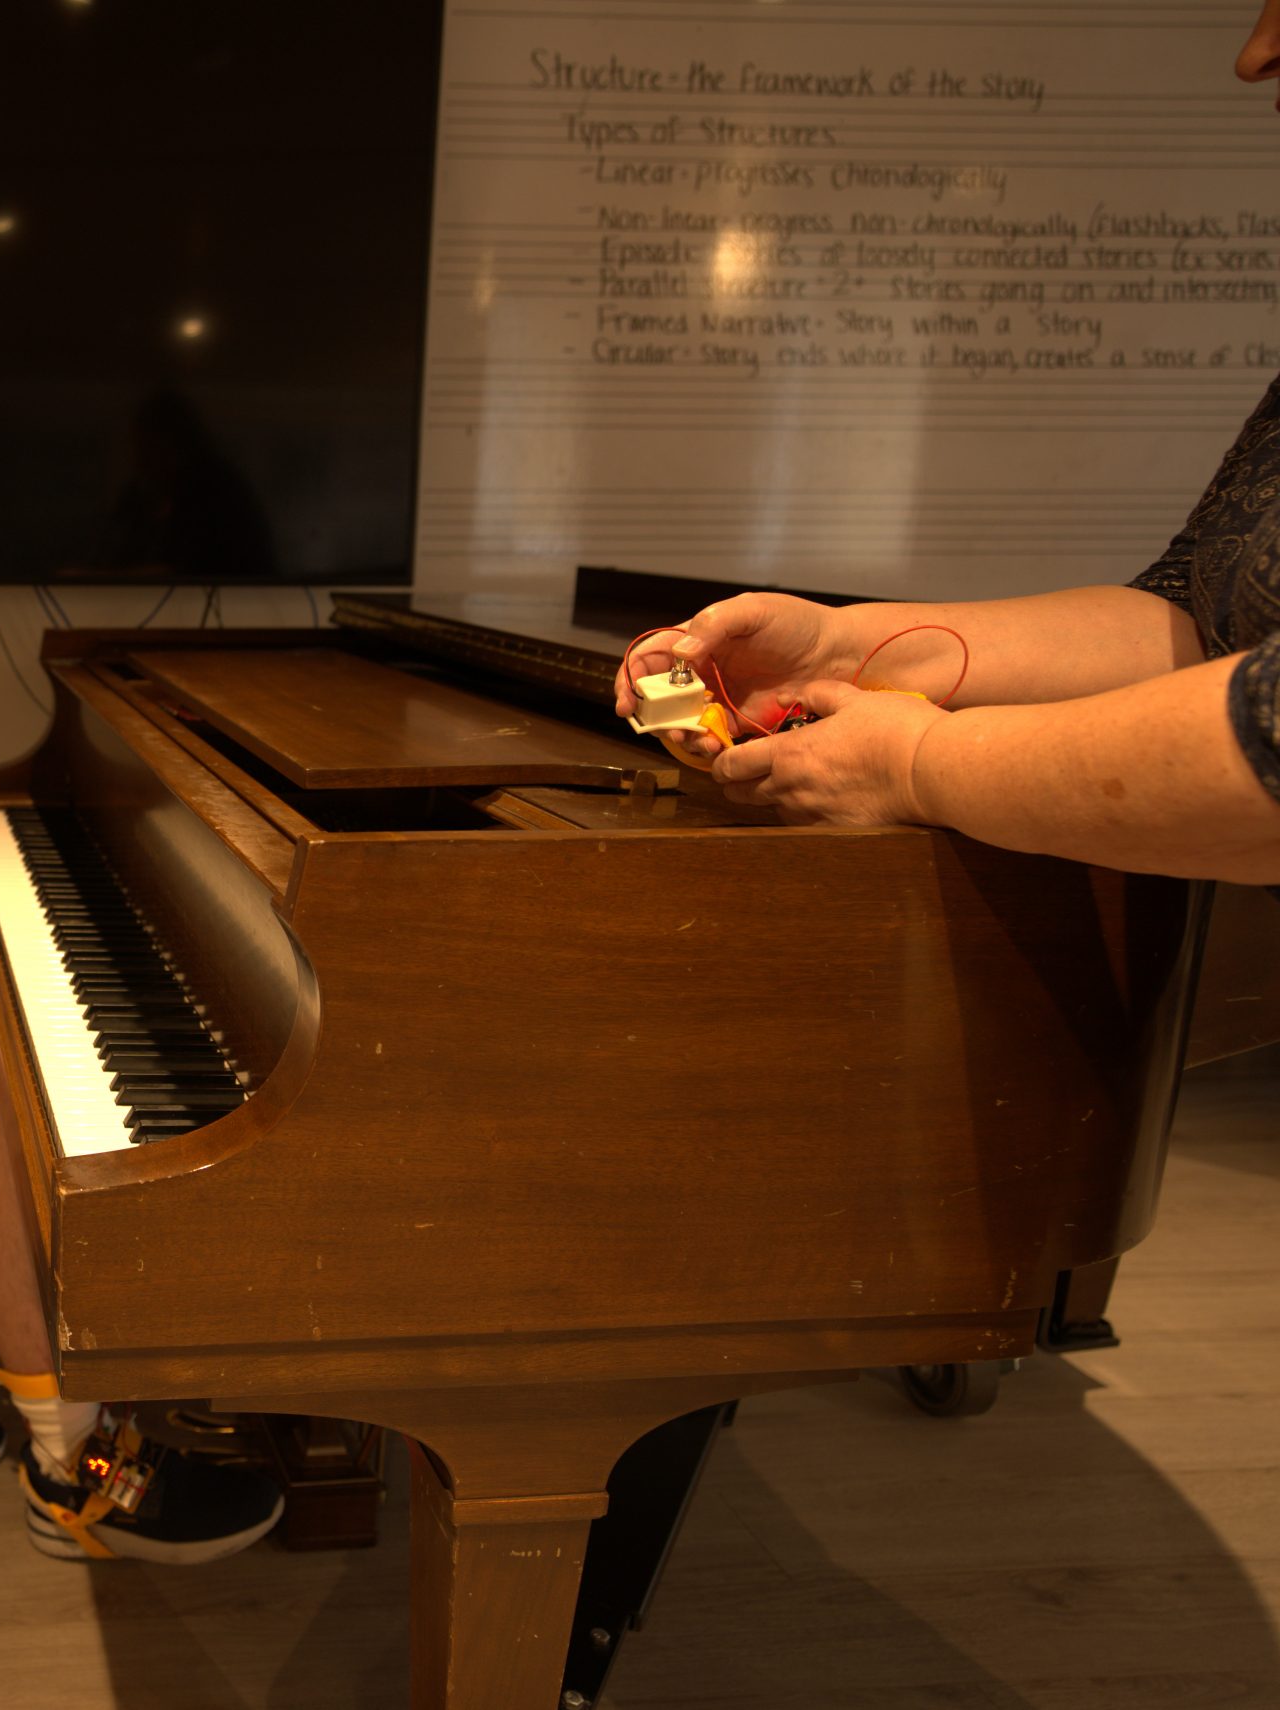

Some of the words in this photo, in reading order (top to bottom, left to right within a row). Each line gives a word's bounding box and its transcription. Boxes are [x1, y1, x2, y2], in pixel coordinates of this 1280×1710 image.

[527, 46, 664, 92] Structure
[888, 65, 916, 98] of
[927, 67, 969, 99] the
